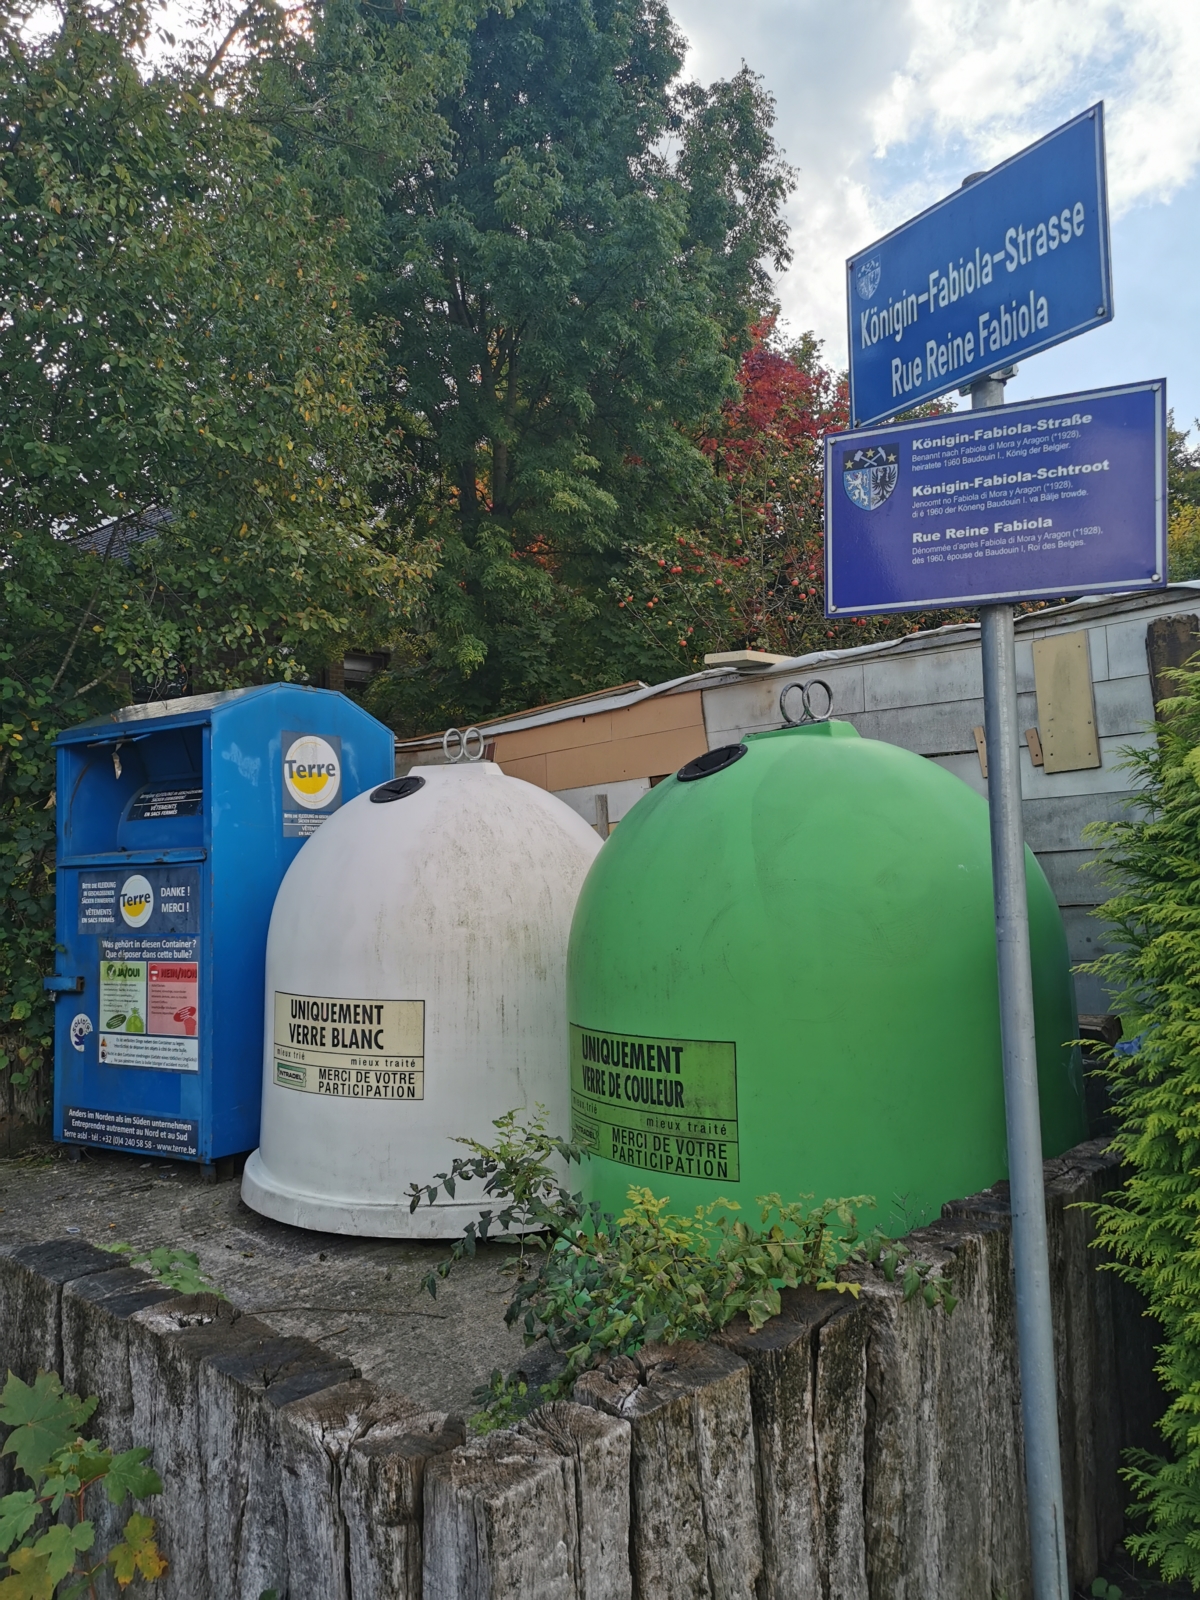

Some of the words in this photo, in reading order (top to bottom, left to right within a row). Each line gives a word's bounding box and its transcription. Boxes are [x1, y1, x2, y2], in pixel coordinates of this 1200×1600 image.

[860, 201, 1085, 349] Königin-Fabiola-Strasse
[891, 356, 922, 398] Rue
[926, 331, 974, 382] Reine
[978, 290, 1049, 357] Fabiola
[912, 413, 1093, 451] Königin-Fabiola-Straße
[912, 452, 941, 462] Benannt
[942, 449, 959, 458] nach
[960, 445, 986, 454] Fabiola
[996, 440, 1015, 449] Mora
[1022, 436, 1049, 445] Aragon
[912, 461, 942, 472] heiratete
[944, 458, 961, 467] 1960
[962, 452, 996, 465] Baudouin
[1006, 448, 1027, 458] König
[1029, 446, 1041, 454] der
[1043, 442, 1071, 453] Belgier.
[912, 459, 1110, 497] Königin-Fabiola-Schtroot
[912, 498, 941, 509] Jenoomt
[953, 493, 979, 503] Fabiola
[989, 489, 1007, 498] Mora
[1009, 489, 1014, 497] y
[1015, 485, 1042, 495] Aragon
[927, 507, 943, 516] 1960
[944, 506, 956, 514] der
[987, 496, 1021, 509] Baudouin
[912, 532, 941, 543] Rue
[945, 526, 989, 539] Reine
[994, 517, 1053, 533] Fabiola
[912, 544, 951, 556] Dénommée
[980, 538, 1006, 548] Fabiola
[1008, 536, 1015, 544] di
[1016, 534, 1035, 543] Mora
[1037, 534, 1042, 542] y
[1043, 530, 1071, 540] Aragon
[912, 556, 925, 565] dès
[947, 551, 973, 562] épouse
[974, 550, 984, 558] de
[985, 545, 1019, 557] Baudouin
[1028, 543, 1041, 551] Roi
[1042, 542, 1056, 550] des
[284, 759, 336, 779] Terre
[120, 893, 151, 907] Terre
[160, 887, 185, 897] DANKE
[85, 907, 112, 916] VÊTEMENTS
[161, 903, 184, 913] MERCI
[102, 940, 114, 948] Was
[115, 940, 133, 949] gehört
[135, 940, 140, 948] in
[141, 940, 160, 948] diesen
[162, 940, 191, 948] Container
[105, 950, 116, 959] Que
[142, 950, 156, 958] dans
[157, 950, 172, 958] cette
[174, 950, 192, 959] bulle?
[117, 966, 140, 979] JA/OUI
[290, 999, 384, 1026] UNIQUEMENT
[289, 1022, 326, 1047] VERRE
[331, 1027, 384, 1050] BLANC
[277, 1048, 291, 1058] mieux
[293, 1052, 305, 1060] trié
[350, 1058, 379, 1067] mieux
[385, 1059, 416, 1068] traité
[582, 1033, 684, 1074] UNIQUEMENT
[279, 1070, 302, 1081] INTRADEL
[318, 1068, 350, 1082] MERCI
[356, 1071, 371, 1084] DE
[375, 1072, 415, 1085] VOTRE
[582, 1064, 606, 1096] VERRE
[609, 1071, 621, 1099] DE
[624, 1074, 684, 1108] COULEUR
[318, 1081, 415, 1098] PARTICIPATION
[587, 1101, 597, 1114] trié
[69, 1109, 87, 1118] Anders
[87, 1110, 94, 1119] im
[95, 1112, 114, 1122] Norden
[124, 1115, 132, 1124] im
[133, 1116, 150, 1126] Süden
[152, 1119, 191, 1131] unternehmen
[72, 1119, 105, 1131] Entreprendre
[106, 1124, 135, 1135] autrement
[145, 1128, 159, 1138] Nord
[160, 1130, 166, 1138] et
[176, 1131, 188, 1141] Sud
[646, 1117, 680, 1131] mieux
[687, 1121, 727, 1135] traité
[64, 1129, 76, 1138] Terre
[77, 1130, 87, 1139] asbl
[102, 1134, 112, 1144] +32
[113, 1136, 124, 1146] (0)4
[125, 1138, 135, 1147] 240
[136, 1139, 143, 1148] 58
[144, 1140, 152, 1149] 58
[157, 1143, 196, 1155] www.terre.be
[612, 1127, 647, 1150] MERCI
[653, 1135, 670, 1153] DE
[675, 1138, 728, 1160] VOTRE
[612, 1144, 728, 1178] PARTICIPATION
